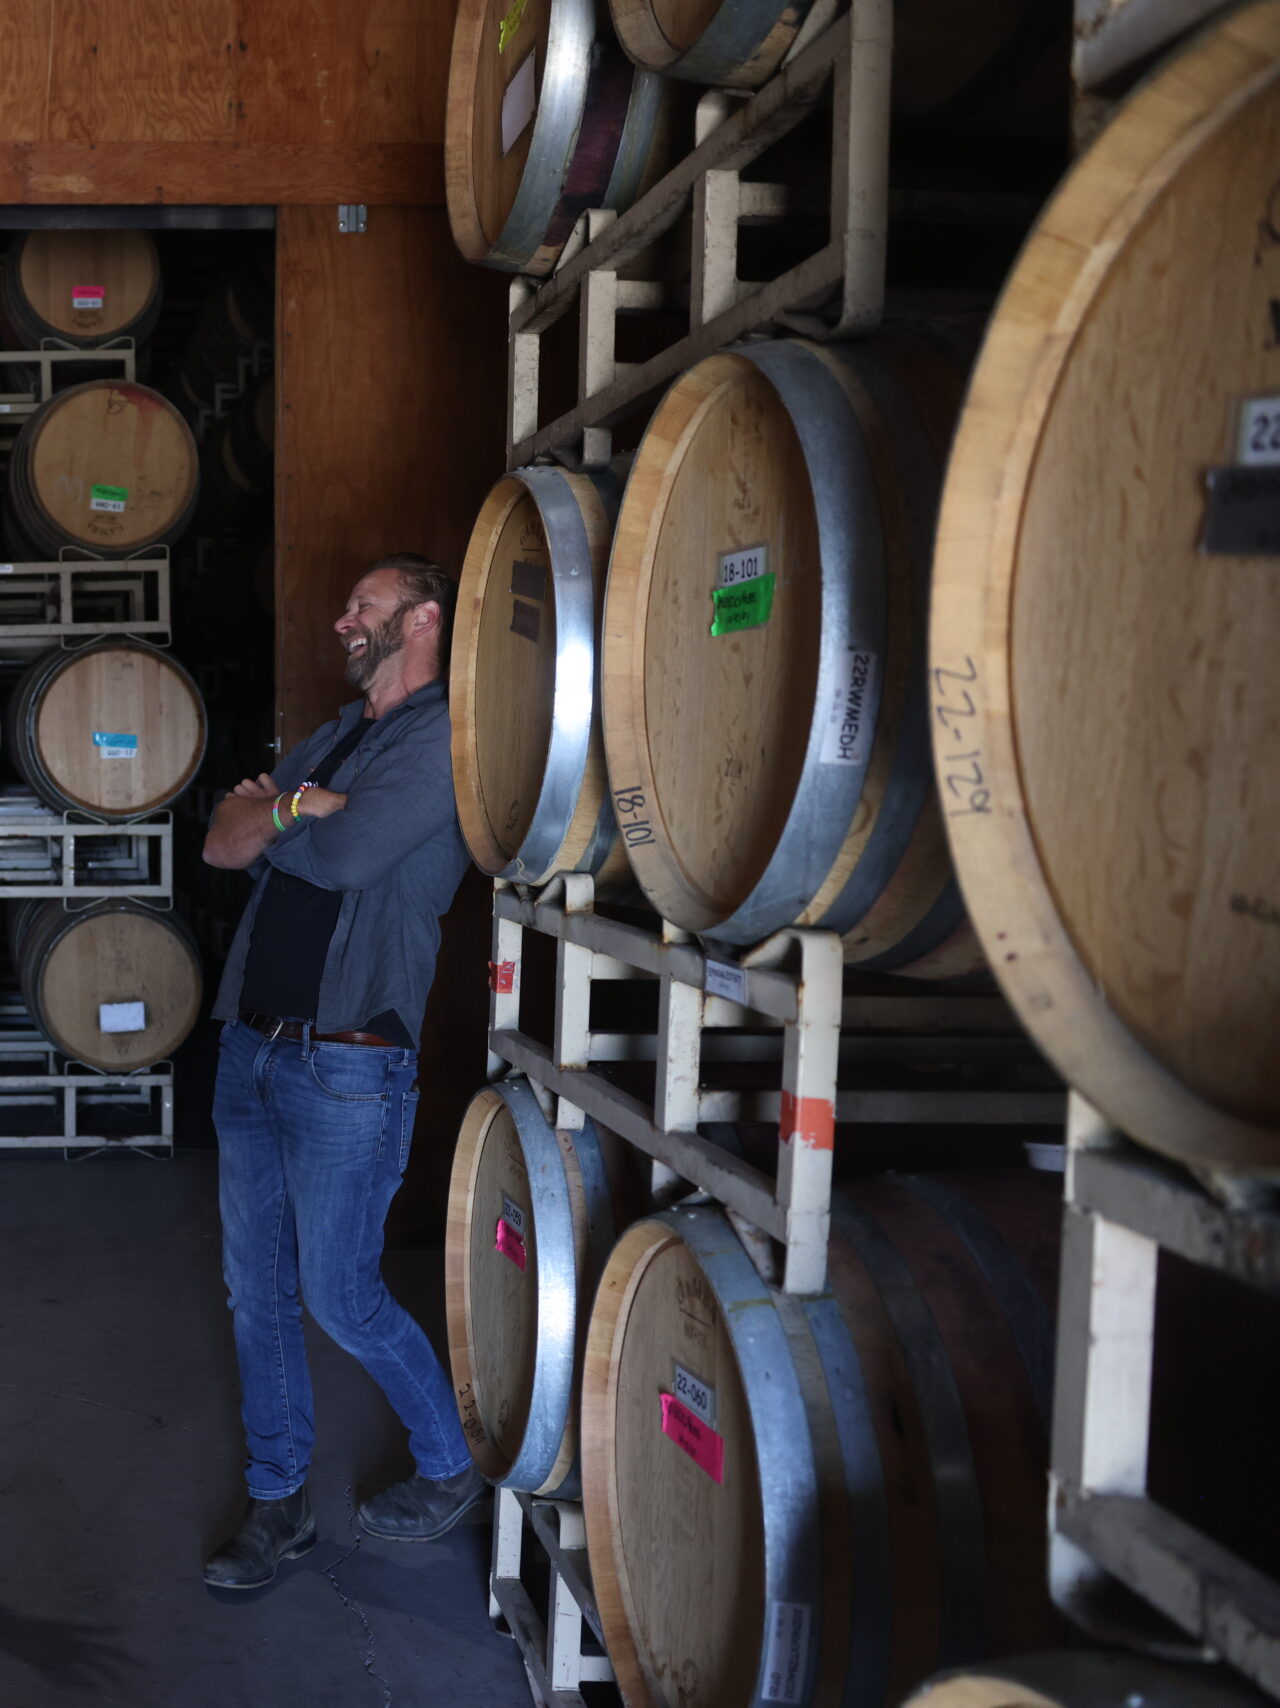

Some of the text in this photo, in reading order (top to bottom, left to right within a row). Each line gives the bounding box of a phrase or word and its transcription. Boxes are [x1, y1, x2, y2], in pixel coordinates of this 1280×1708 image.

[724, 556, 758, 583] 18-101
[837, 653, 869, 761] 22RWMEDH
[614, 786, 656, 848] 18-101
[504, 1202, 522, 1227] 22-059
[677, 1373, 708, 1410] 22-060
